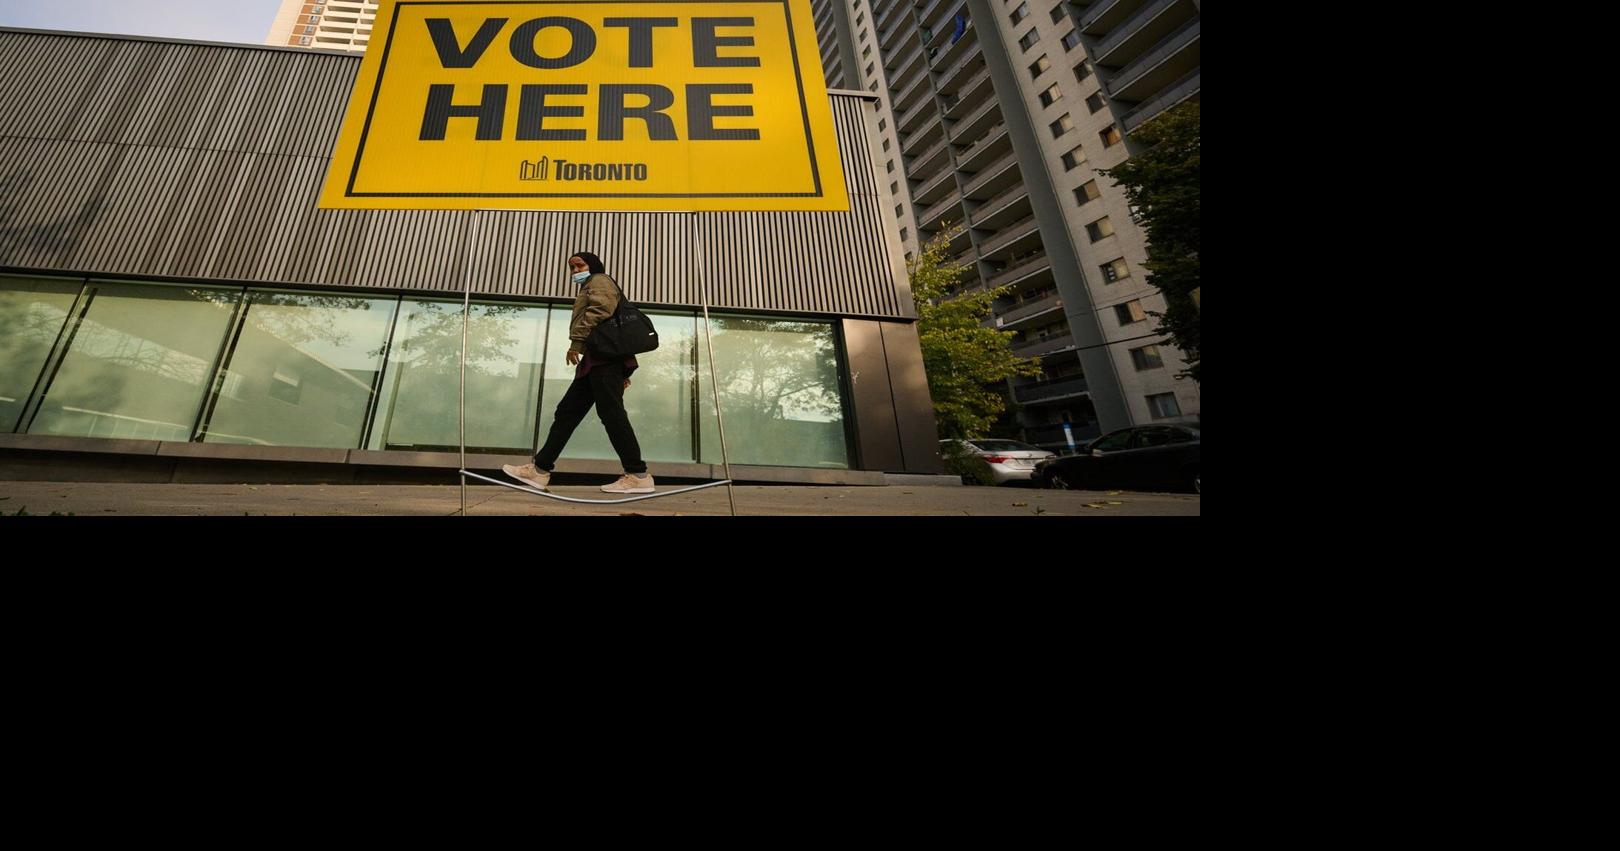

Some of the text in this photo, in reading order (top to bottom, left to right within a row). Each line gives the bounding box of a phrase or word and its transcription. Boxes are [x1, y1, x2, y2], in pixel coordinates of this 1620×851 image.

[424, 16, 761, 69] VOTE
[418, 83, 761, 141] HERE
[553, 159, 648, 181] TORONTO
